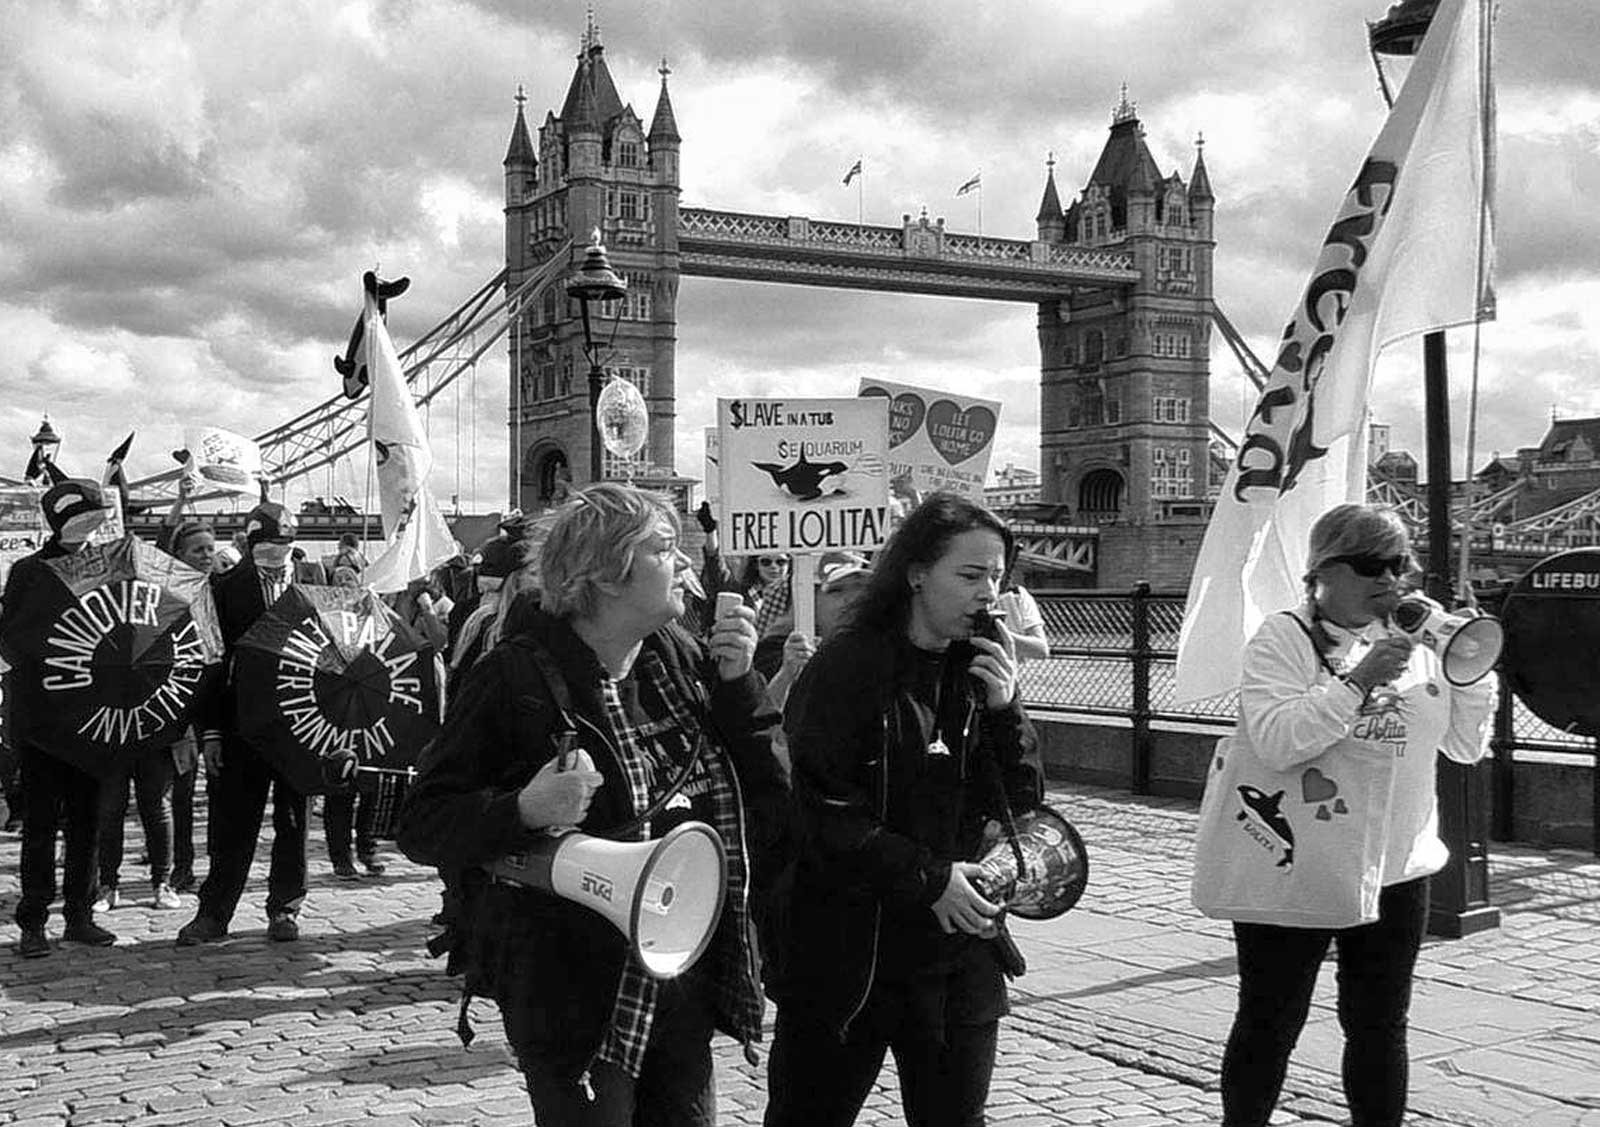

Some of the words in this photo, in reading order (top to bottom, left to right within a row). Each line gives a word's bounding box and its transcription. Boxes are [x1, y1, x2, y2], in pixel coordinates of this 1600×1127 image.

[787, 412, 798, 426] IN
[800, 412, 807, 426] A
[778, 439, 864, 460] SEQUARIUM
[732, 511, 779, 551] FREE
[789, 507, 886, 549] LOLITA!
[42, 580, 162, 693] CANDOVER
[341, 610, 424, 715] PALACE
[276, 617, 397, 759] ENTERTAINMENT
[581, 875, 614, 903] PYLE
